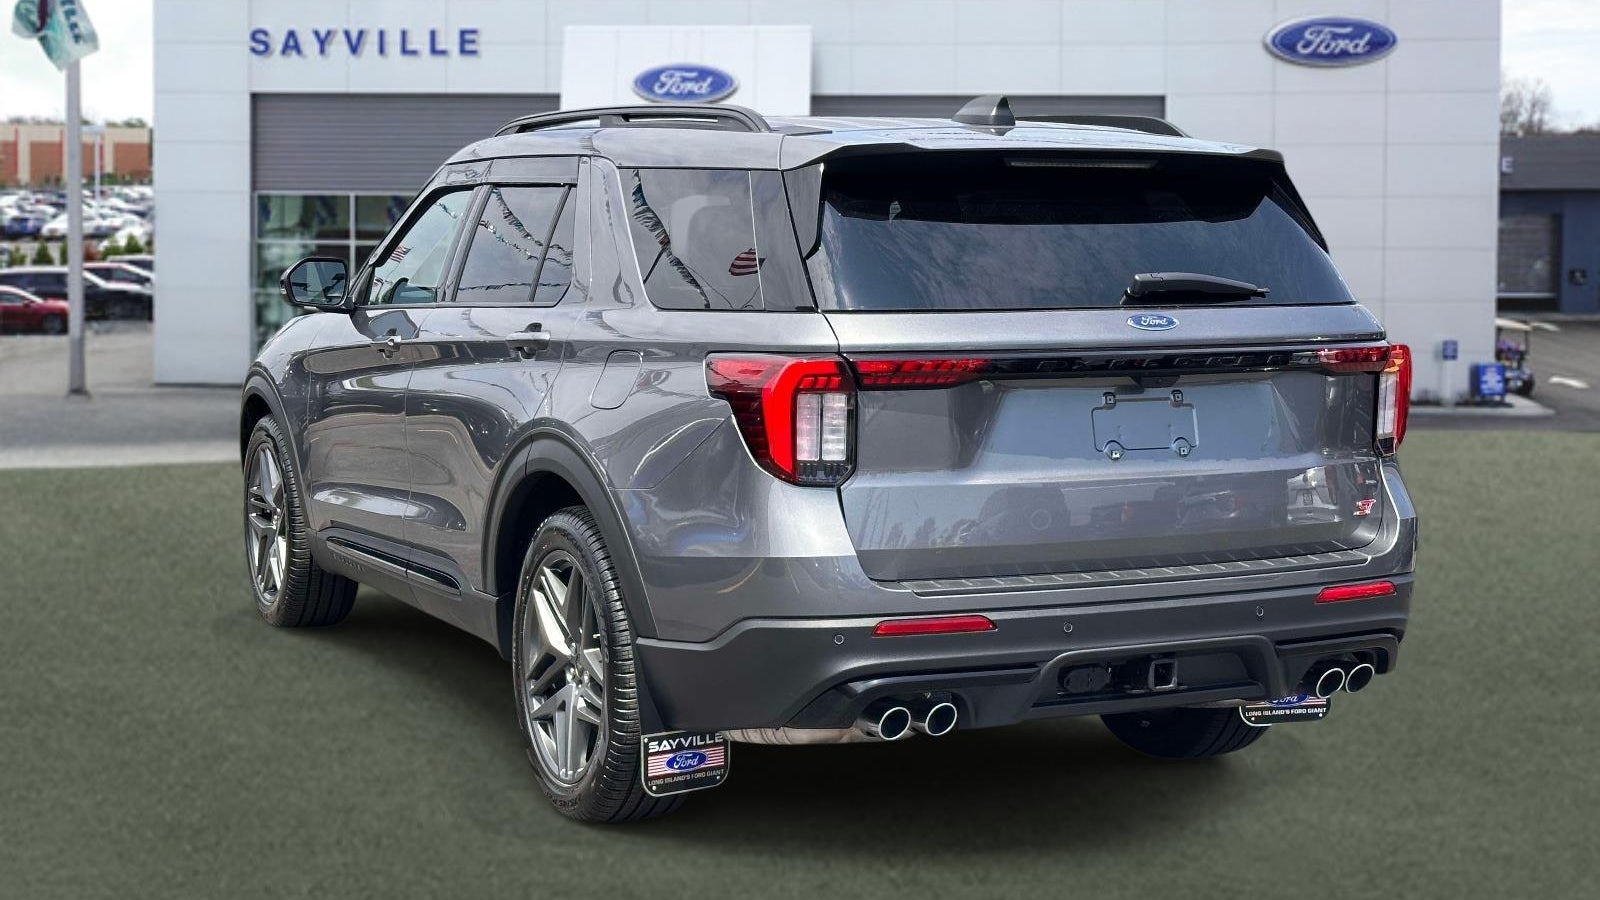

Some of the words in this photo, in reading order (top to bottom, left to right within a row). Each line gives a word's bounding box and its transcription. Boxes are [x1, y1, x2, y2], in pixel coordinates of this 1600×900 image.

[249, 28, 479, 56] SAYVILLE
[1297, 25, 1372, 54] Ford
[653, 70, 713, 94] Ford
[1140, 315, 1168, 326] Ford
[1262, 708, 1290, 716] ISLAND'S
[648, 732, 724, 753] SAYVILLE
[673, 754, 700, 769] Ford
[648, 778, 664, 786] LONG
[664, 774, 691, 785] ISLAND'S
[691, 771, 706, 780] FORD
[706, 768, 724, 777] GIANT
